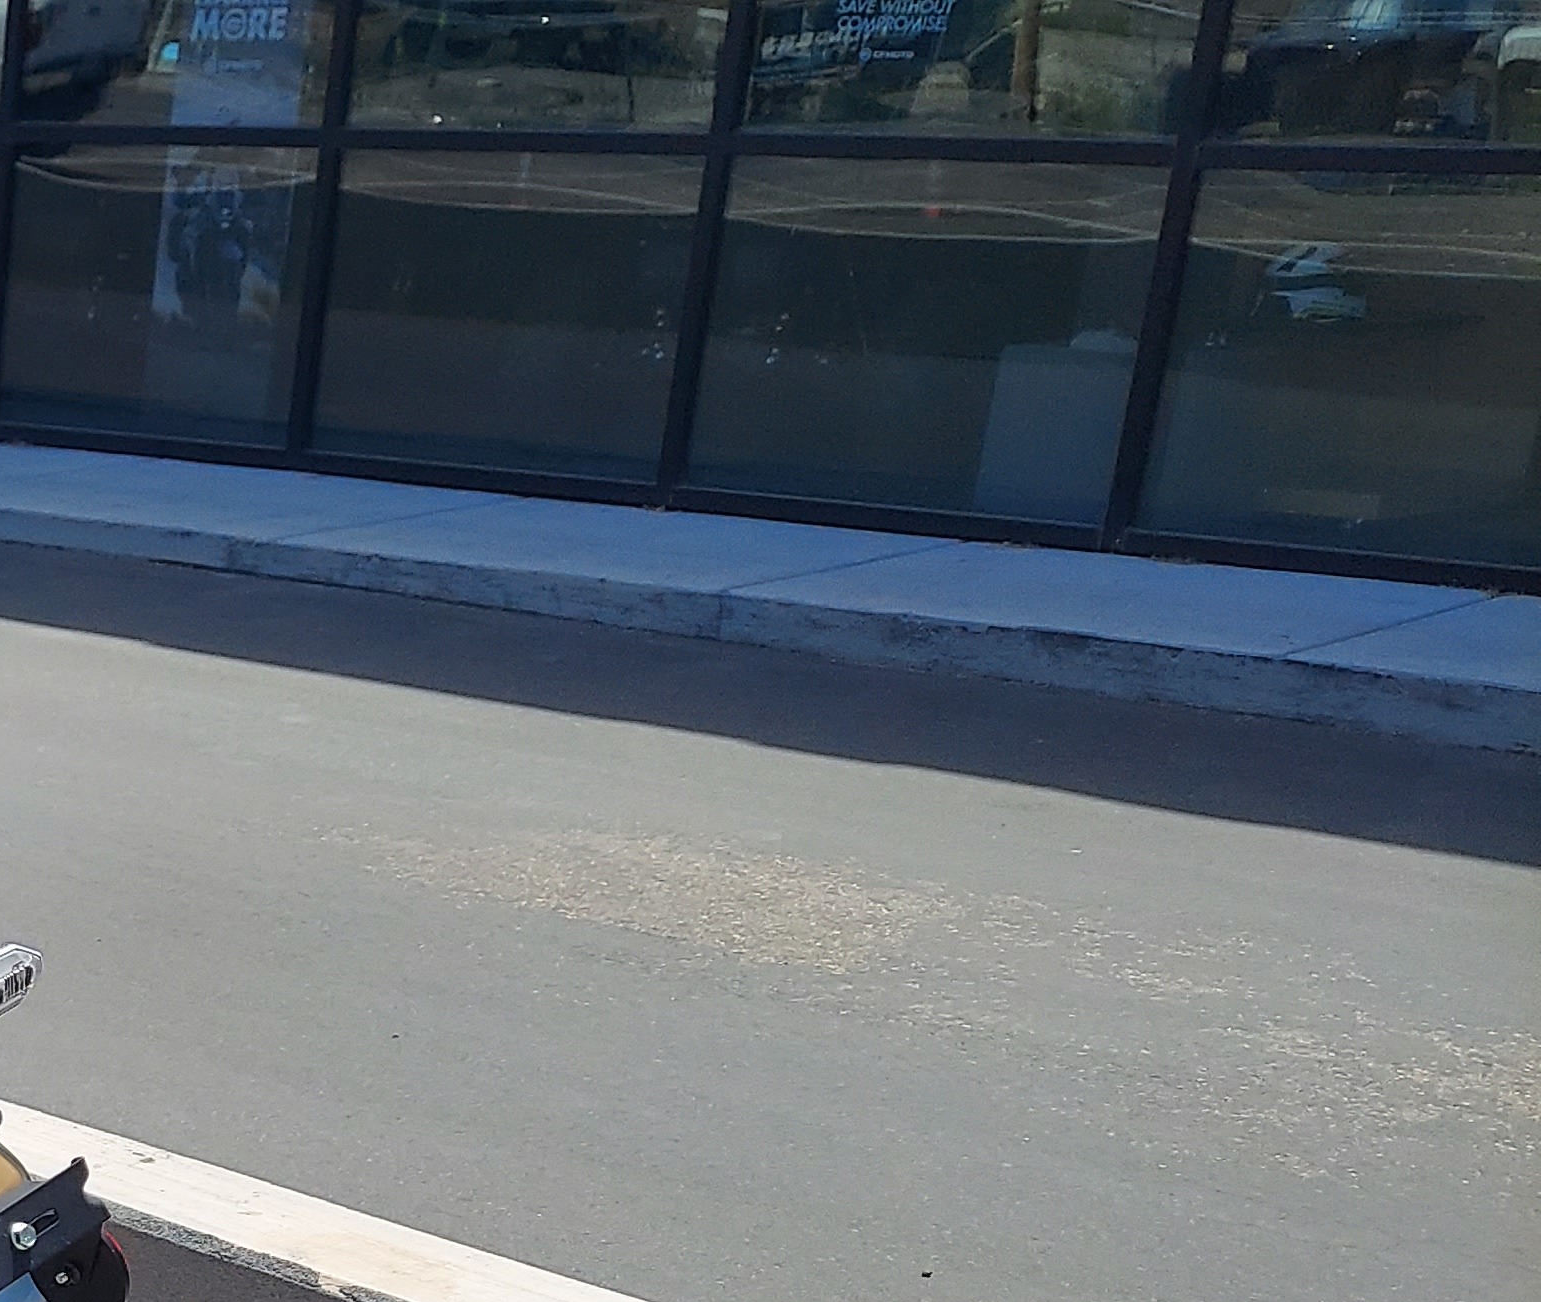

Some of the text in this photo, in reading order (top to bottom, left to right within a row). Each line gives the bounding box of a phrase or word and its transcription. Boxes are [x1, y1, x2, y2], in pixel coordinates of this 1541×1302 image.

[837, 0, 955, 14] SAVE WITHOUT
[190, 7, 288, 40] MORE
